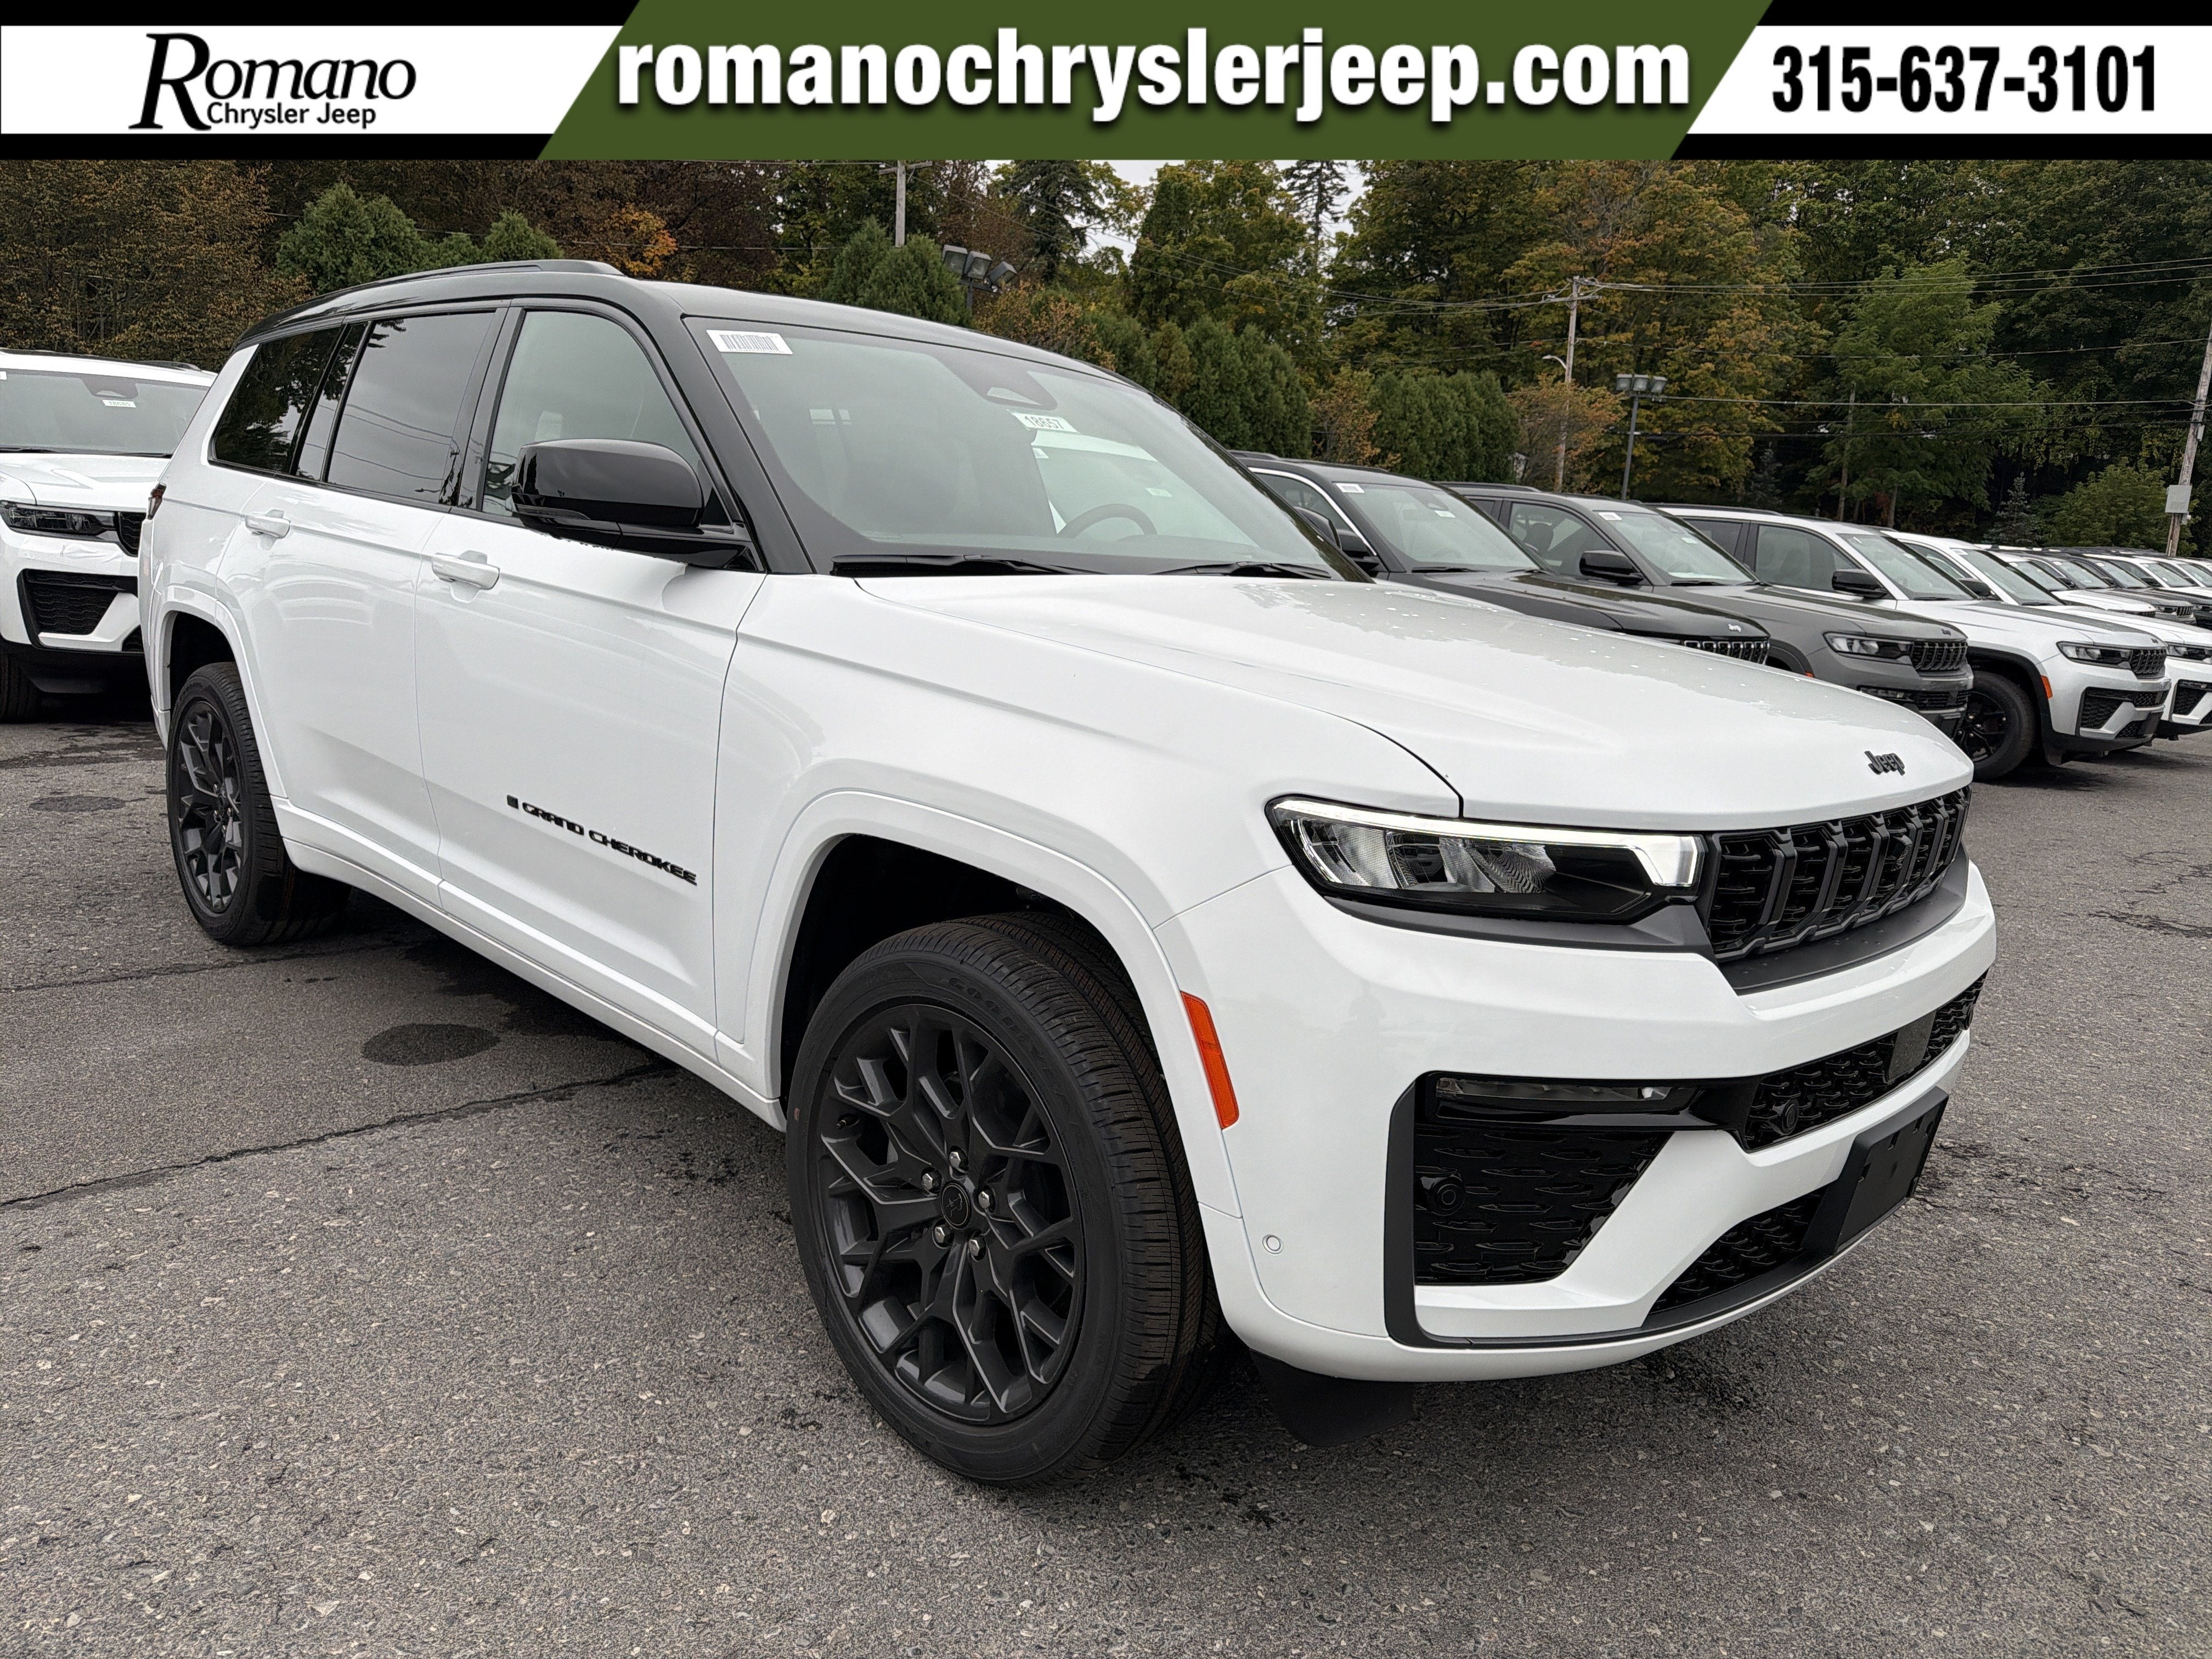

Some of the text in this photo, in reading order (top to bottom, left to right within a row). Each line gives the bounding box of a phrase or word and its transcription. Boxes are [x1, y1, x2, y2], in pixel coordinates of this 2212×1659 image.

[1024, 416, 1064, 430] 18657
[1864, 751, 1905, 776] Jeep
[522, 802, 697, 886] GRAND CHEROKEE
